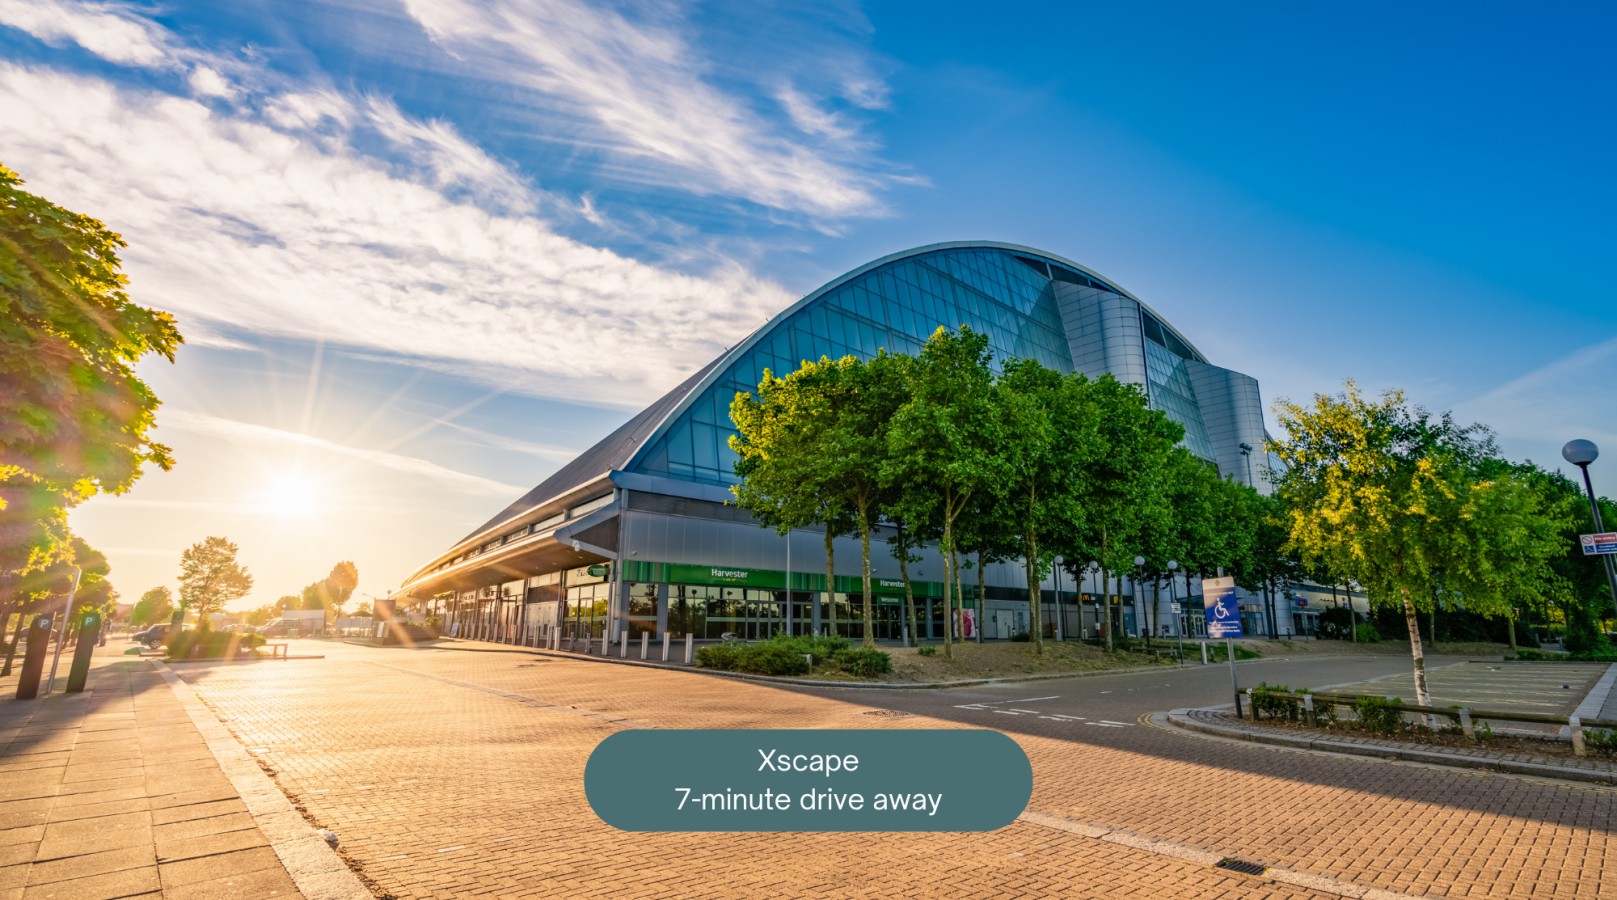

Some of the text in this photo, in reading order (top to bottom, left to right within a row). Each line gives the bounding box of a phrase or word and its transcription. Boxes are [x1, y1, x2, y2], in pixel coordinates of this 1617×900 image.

[711, 568, 748, 578] Harvester
[880, 579, 905, 588] Harvester
[40, 619, 48, 628] P
[85, 617, 93, 625] P
